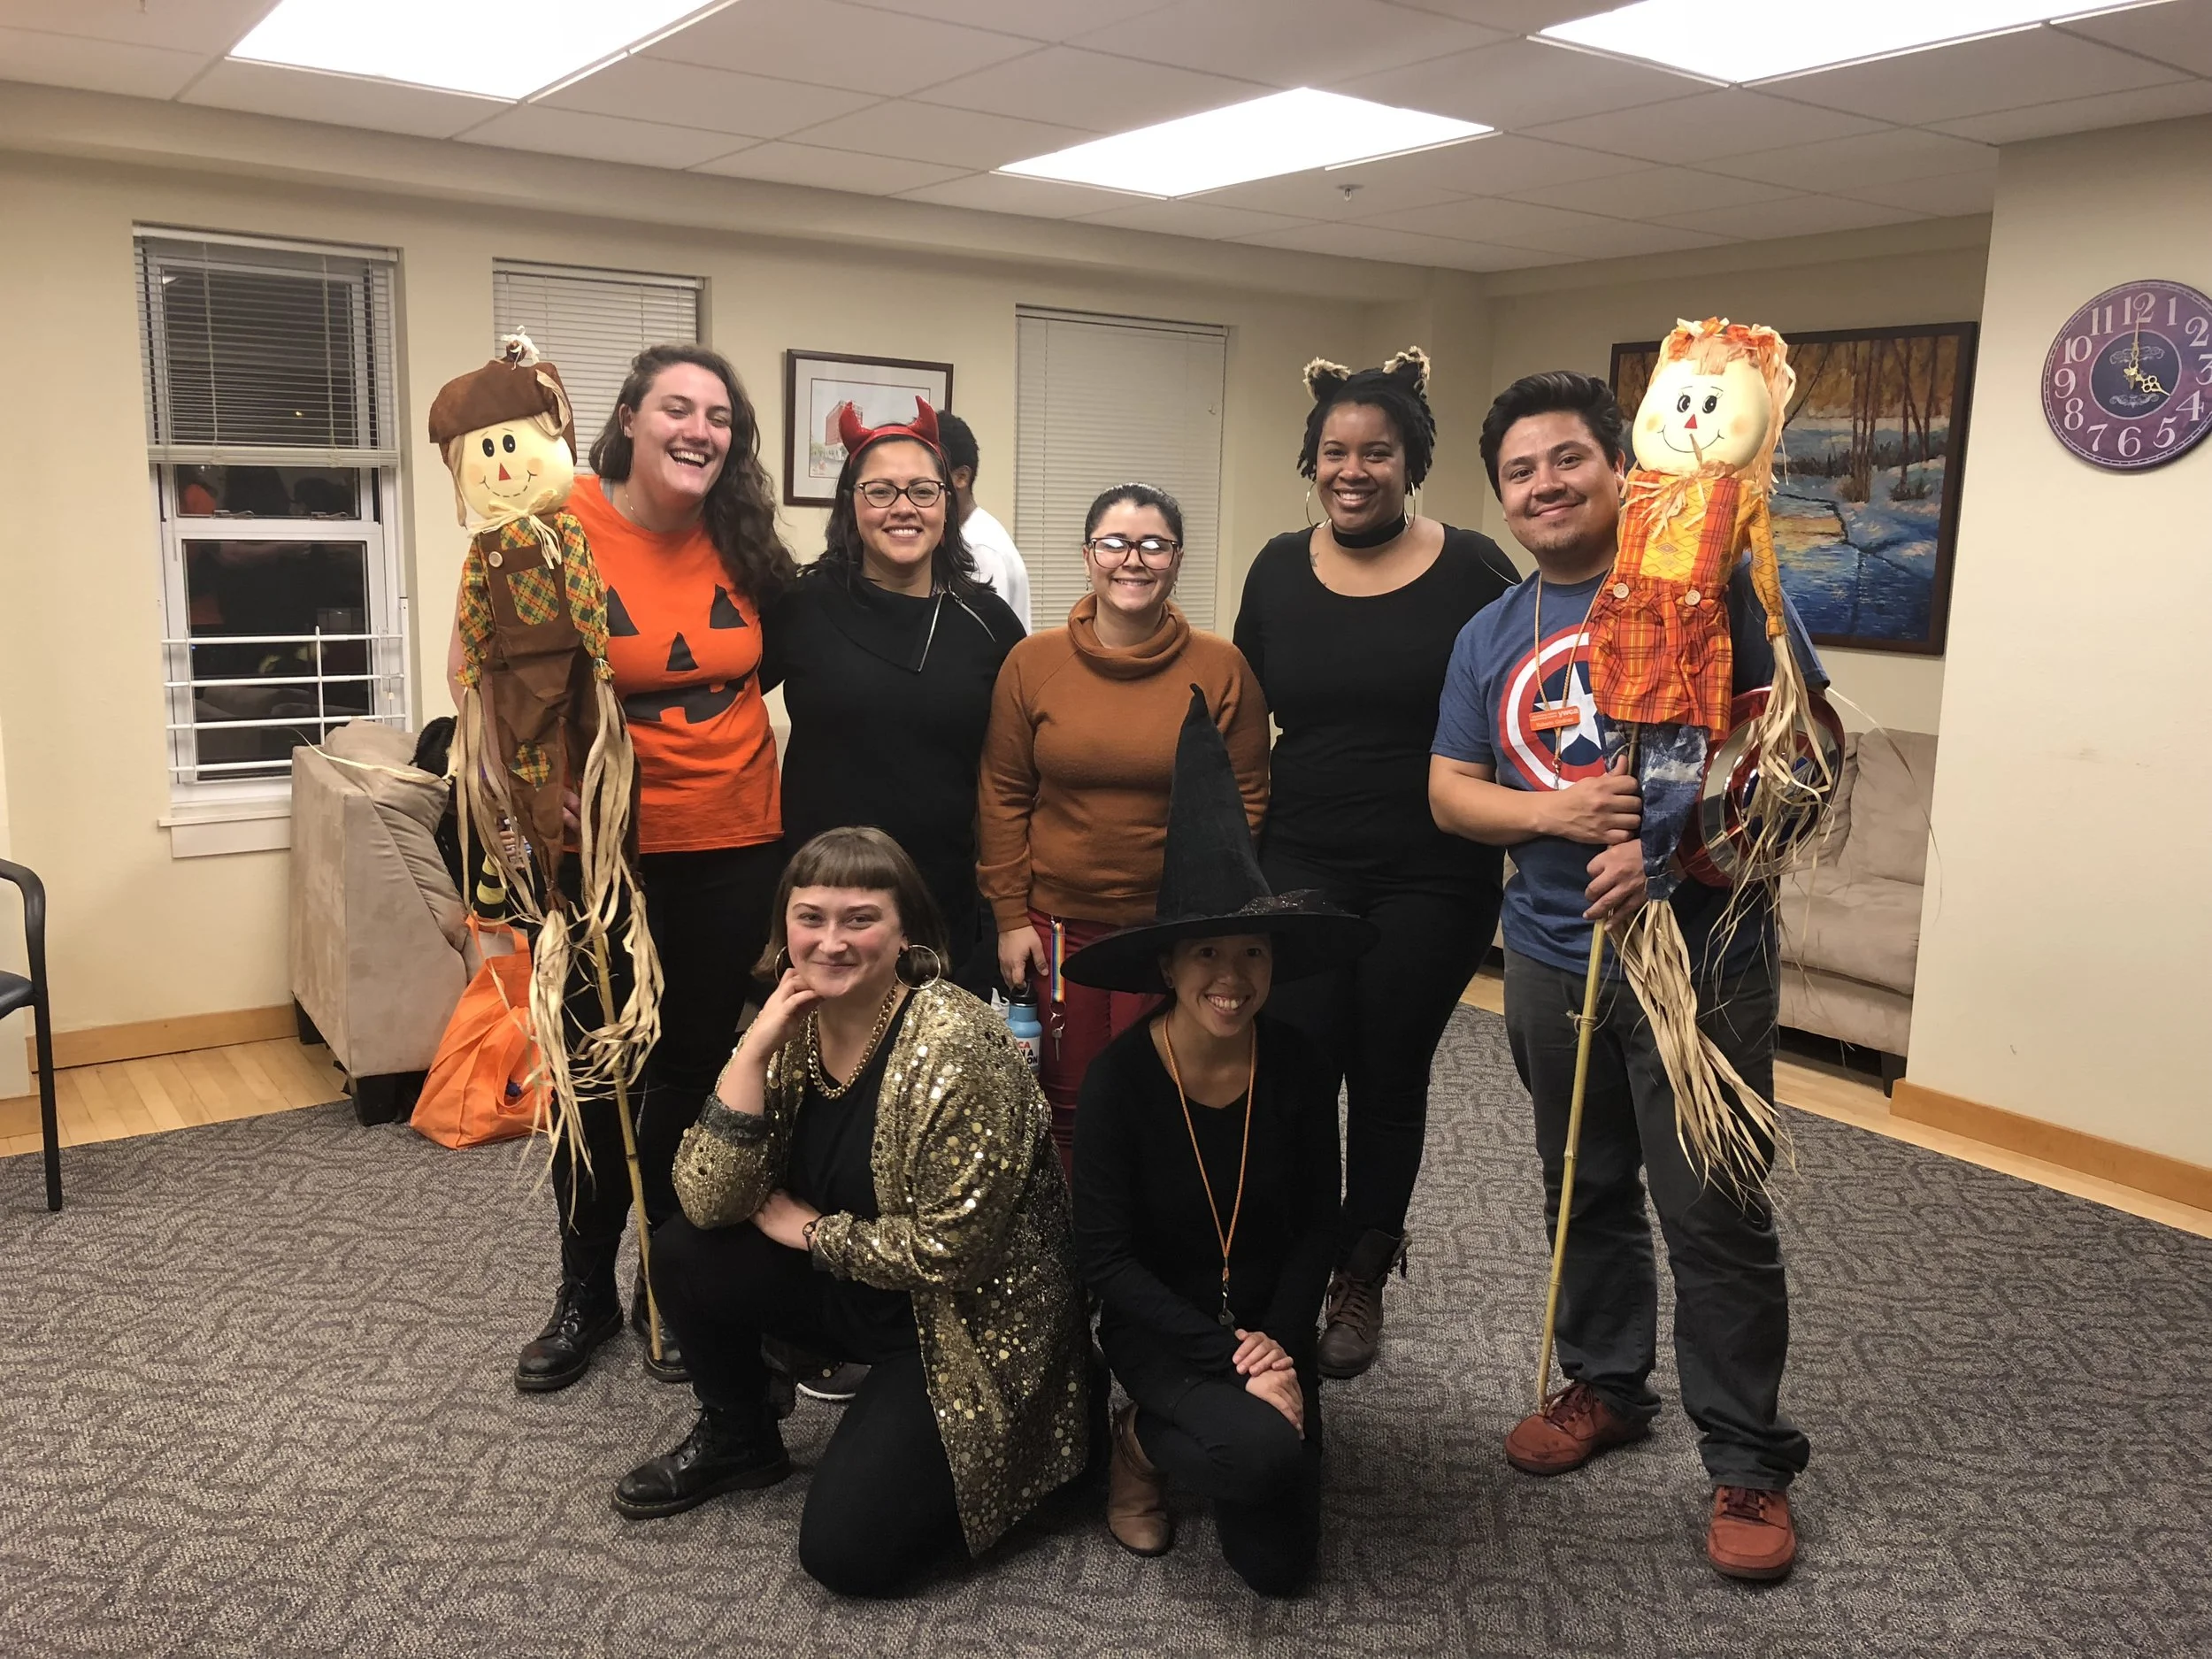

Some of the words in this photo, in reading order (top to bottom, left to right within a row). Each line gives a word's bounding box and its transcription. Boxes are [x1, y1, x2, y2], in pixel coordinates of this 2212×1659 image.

[2090, 304, 2113, 335] 11
[2122, 292, 2155, 325] 12
[2166, 296, 2177, 326] 1
[2185, 316, 2209, 347] 2
[2062, 335, 2093, 365] 10
[2054, 368, 2076, 399] 9
[2195, 353, 2212, 385] 3
[2063, 397, 2084, 430] 8
[2175, 389, 2204, 422] 4
[2086, 423, 2108, 452] 7
[2117, 426, 2141, 457] 6
[2153, 416, 2177, 449] 5
[1558, 709, 1578, 718] ywca
